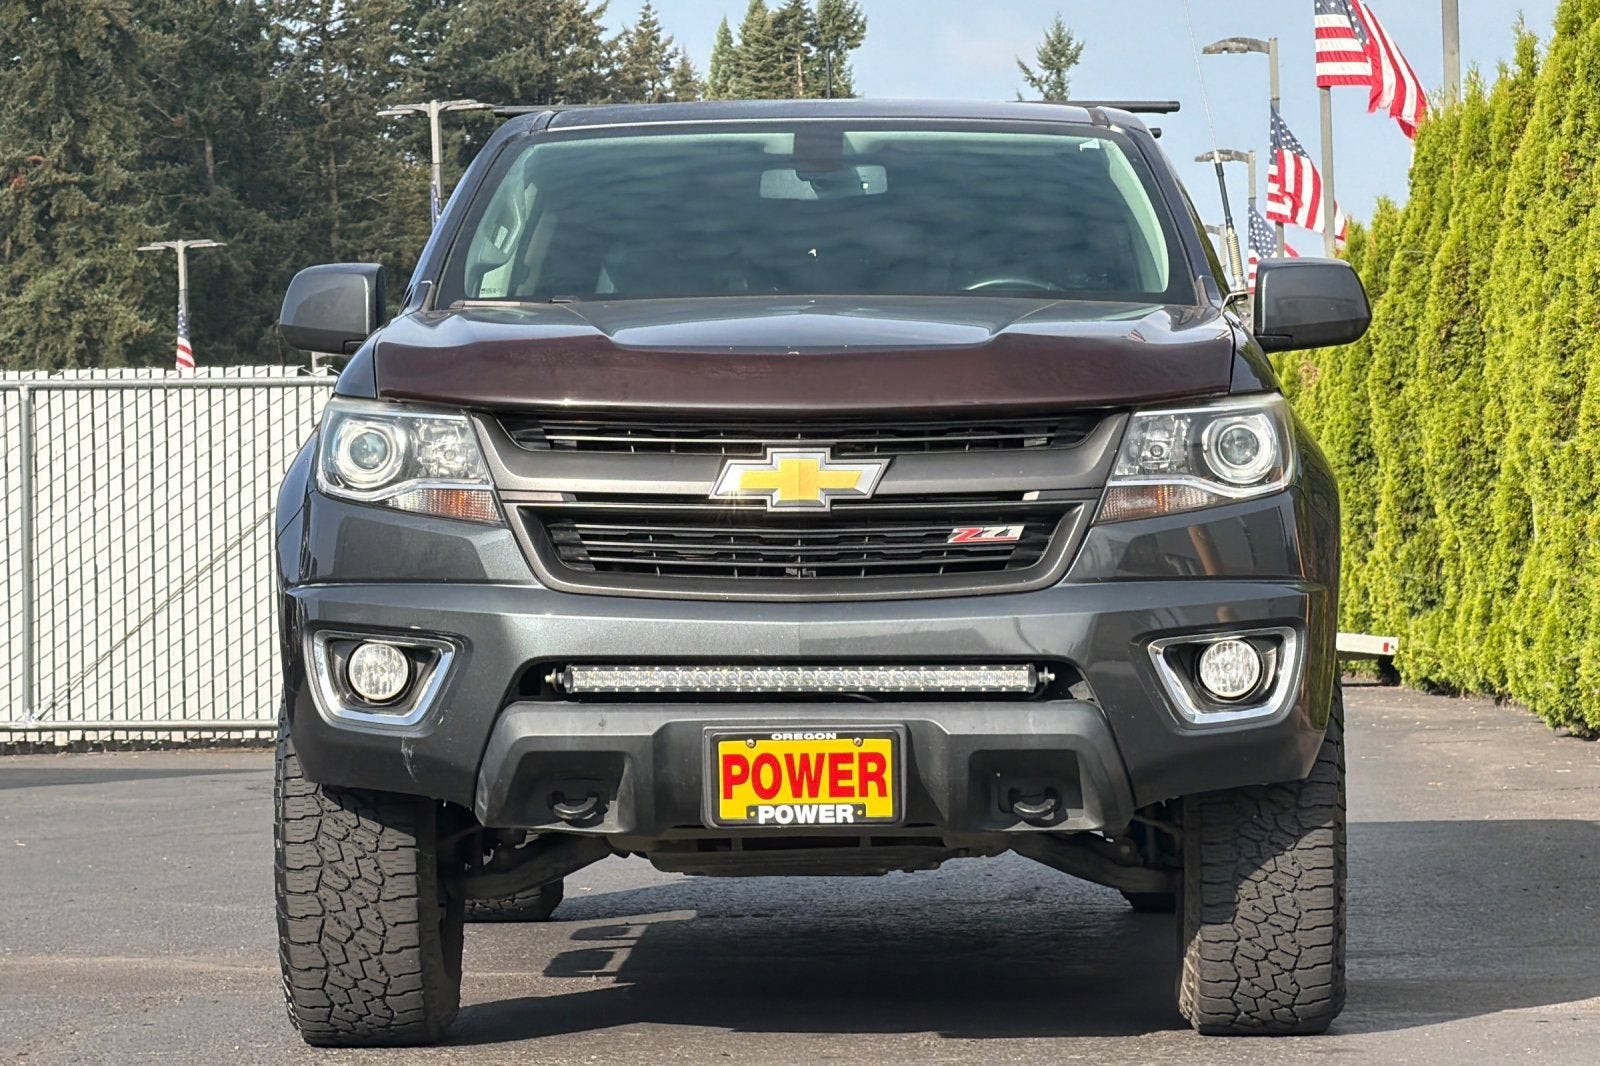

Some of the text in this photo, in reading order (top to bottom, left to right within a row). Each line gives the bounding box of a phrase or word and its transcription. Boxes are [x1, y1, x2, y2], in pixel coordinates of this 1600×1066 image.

[947, 525, 1025, 543] Z71
[771, 732, 837, 741] OREGON
[722, 752, 888, 800] POWER
[758, 804, 854, 824] POWER
